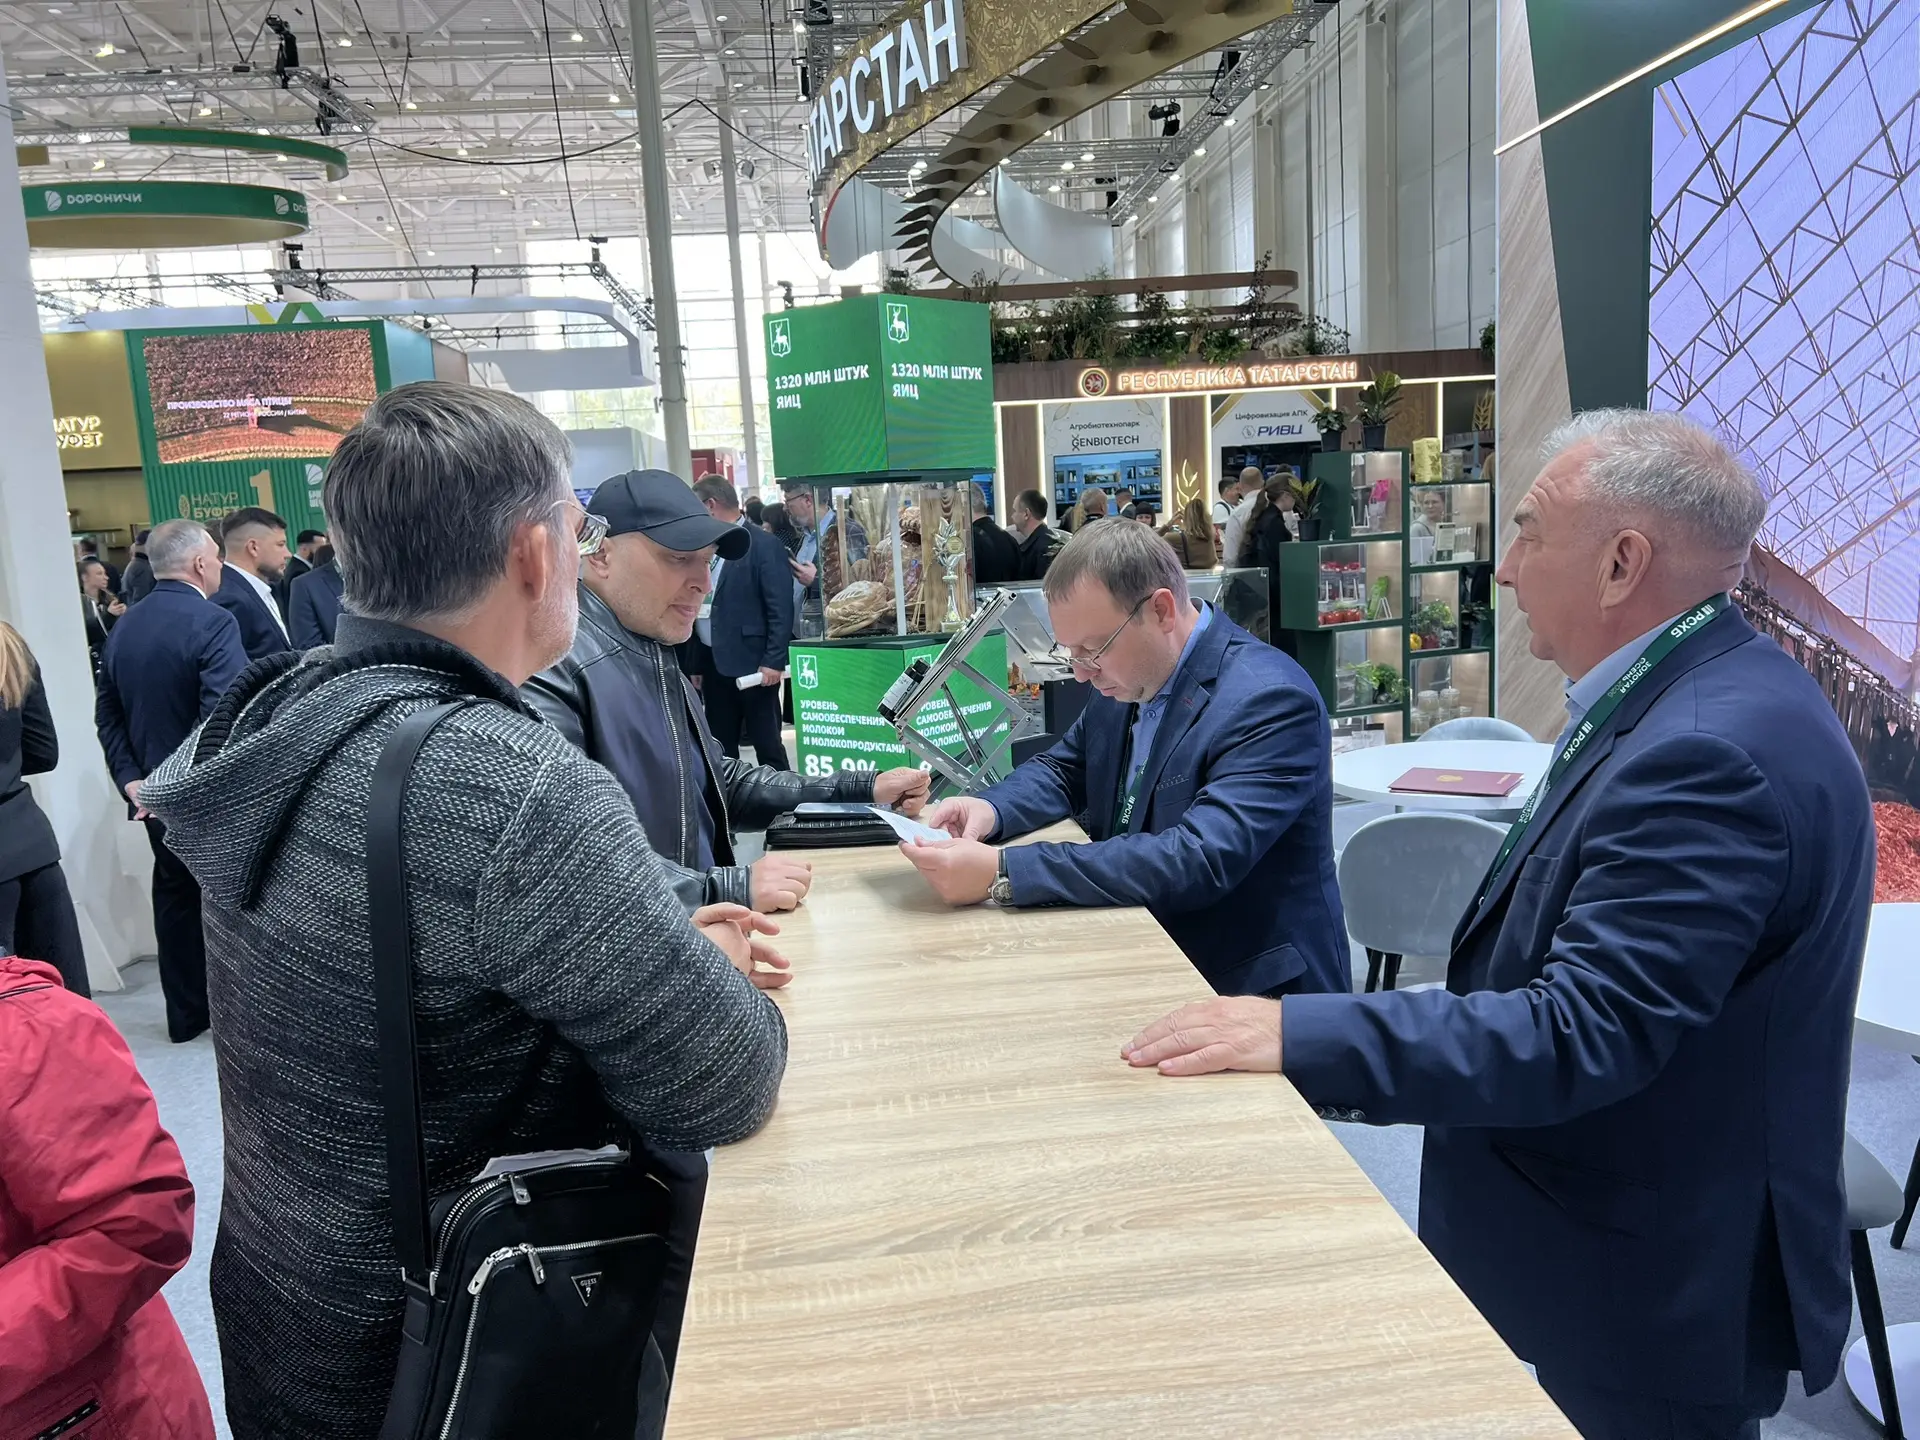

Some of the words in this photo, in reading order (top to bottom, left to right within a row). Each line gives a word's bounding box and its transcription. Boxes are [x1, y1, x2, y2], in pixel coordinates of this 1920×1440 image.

[775, 374, 802, 390] 1320
[804, 369, 831, 386] МЛН
[834, 364, 869, 382] ШТУК
[892, 362, 920, 377] 1320
[922, 365, 948, 378] МЛН
[951, 366, 982, 380] ШТУК
[1118, 367, 1246, 391] РЕСПУБЛИКА
[1248, 361, 1357, 384] ТАТАРСТАН
[893, 384, 918, 400] ЯИЦ
[777, 393, 801, 409] ЯИЦ
[1235, 411, 1290, 420] Цифровизация
[1292, 409, 1308, 417] АПК
[1070, 421, 1140, 430] Агробиотехнопарк
[1257, 424, 1303, 436] РИВЦ
[56, 431, 103, 449] УФЕТ
[1071, 434, 1139, 449] GENBIOTECH
[191, 492, 238, 505] НАТУР
[1670, 611, 1706, 638] РСХБ
[1620, 661, 1652, 693] ЗОЛОТАЯ
[1622, 657, 1646, 681] ОСЕНЬ
[800, 700, 838, 711] УРОВЕНЬ
[801, 712, 885, 726] САМООБЕСПЕЧЕНИЯ
[803, 736, 809, 745] И
[1563, 731, 1586, 761] РСХБ
[1121, 803, 1134, 825] РСХБ
